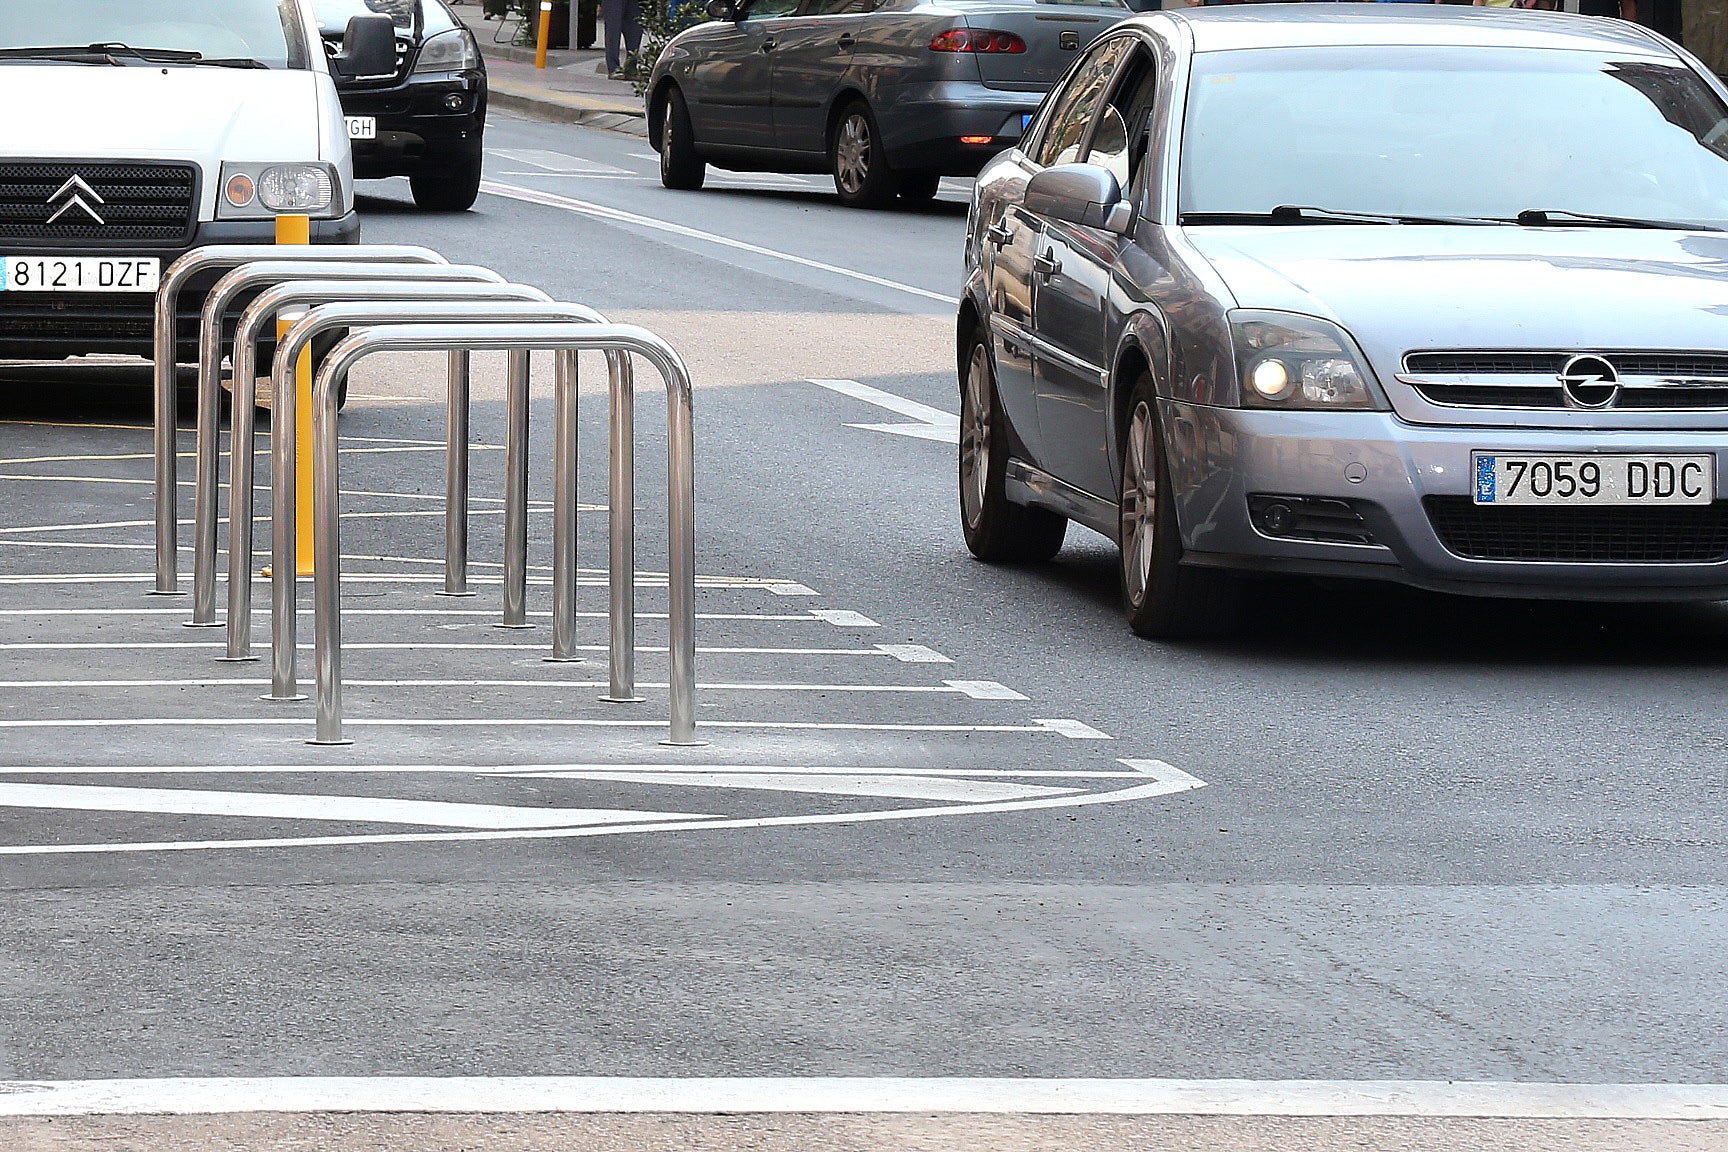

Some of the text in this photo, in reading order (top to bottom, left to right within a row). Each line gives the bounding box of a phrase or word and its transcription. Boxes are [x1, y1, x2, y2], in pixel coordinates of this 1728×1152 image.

[345, 119, 371, 136] GH
[14, 261, 82, 287] 8121
[98, 261, 151, 287] DZF
[1505, 461, 1601, 498] 7059
[1627, 461, 1702, 498] DDC
